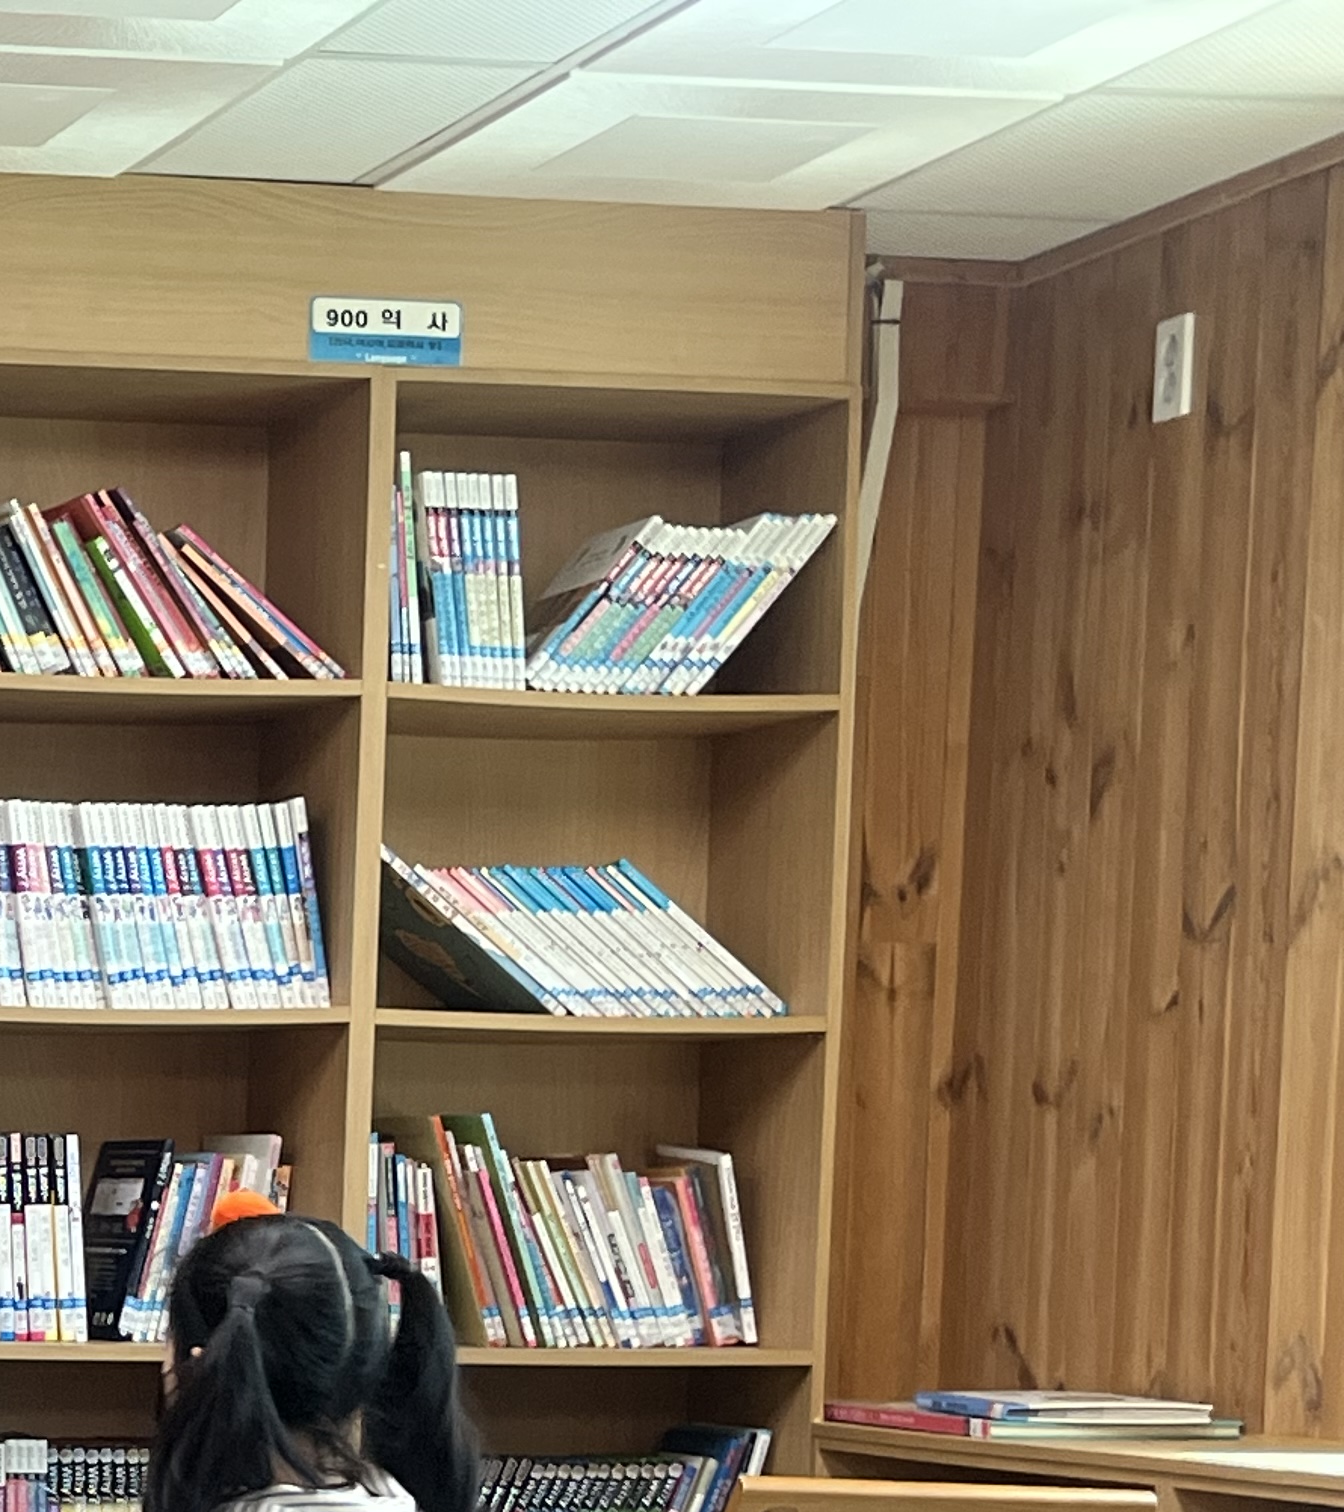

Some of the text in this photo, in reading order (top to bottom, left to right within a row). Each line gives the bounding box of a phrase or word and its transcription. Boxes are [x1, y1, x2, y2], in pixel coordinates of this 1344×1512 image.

[326, 308, 448, 332] 900 역 사
